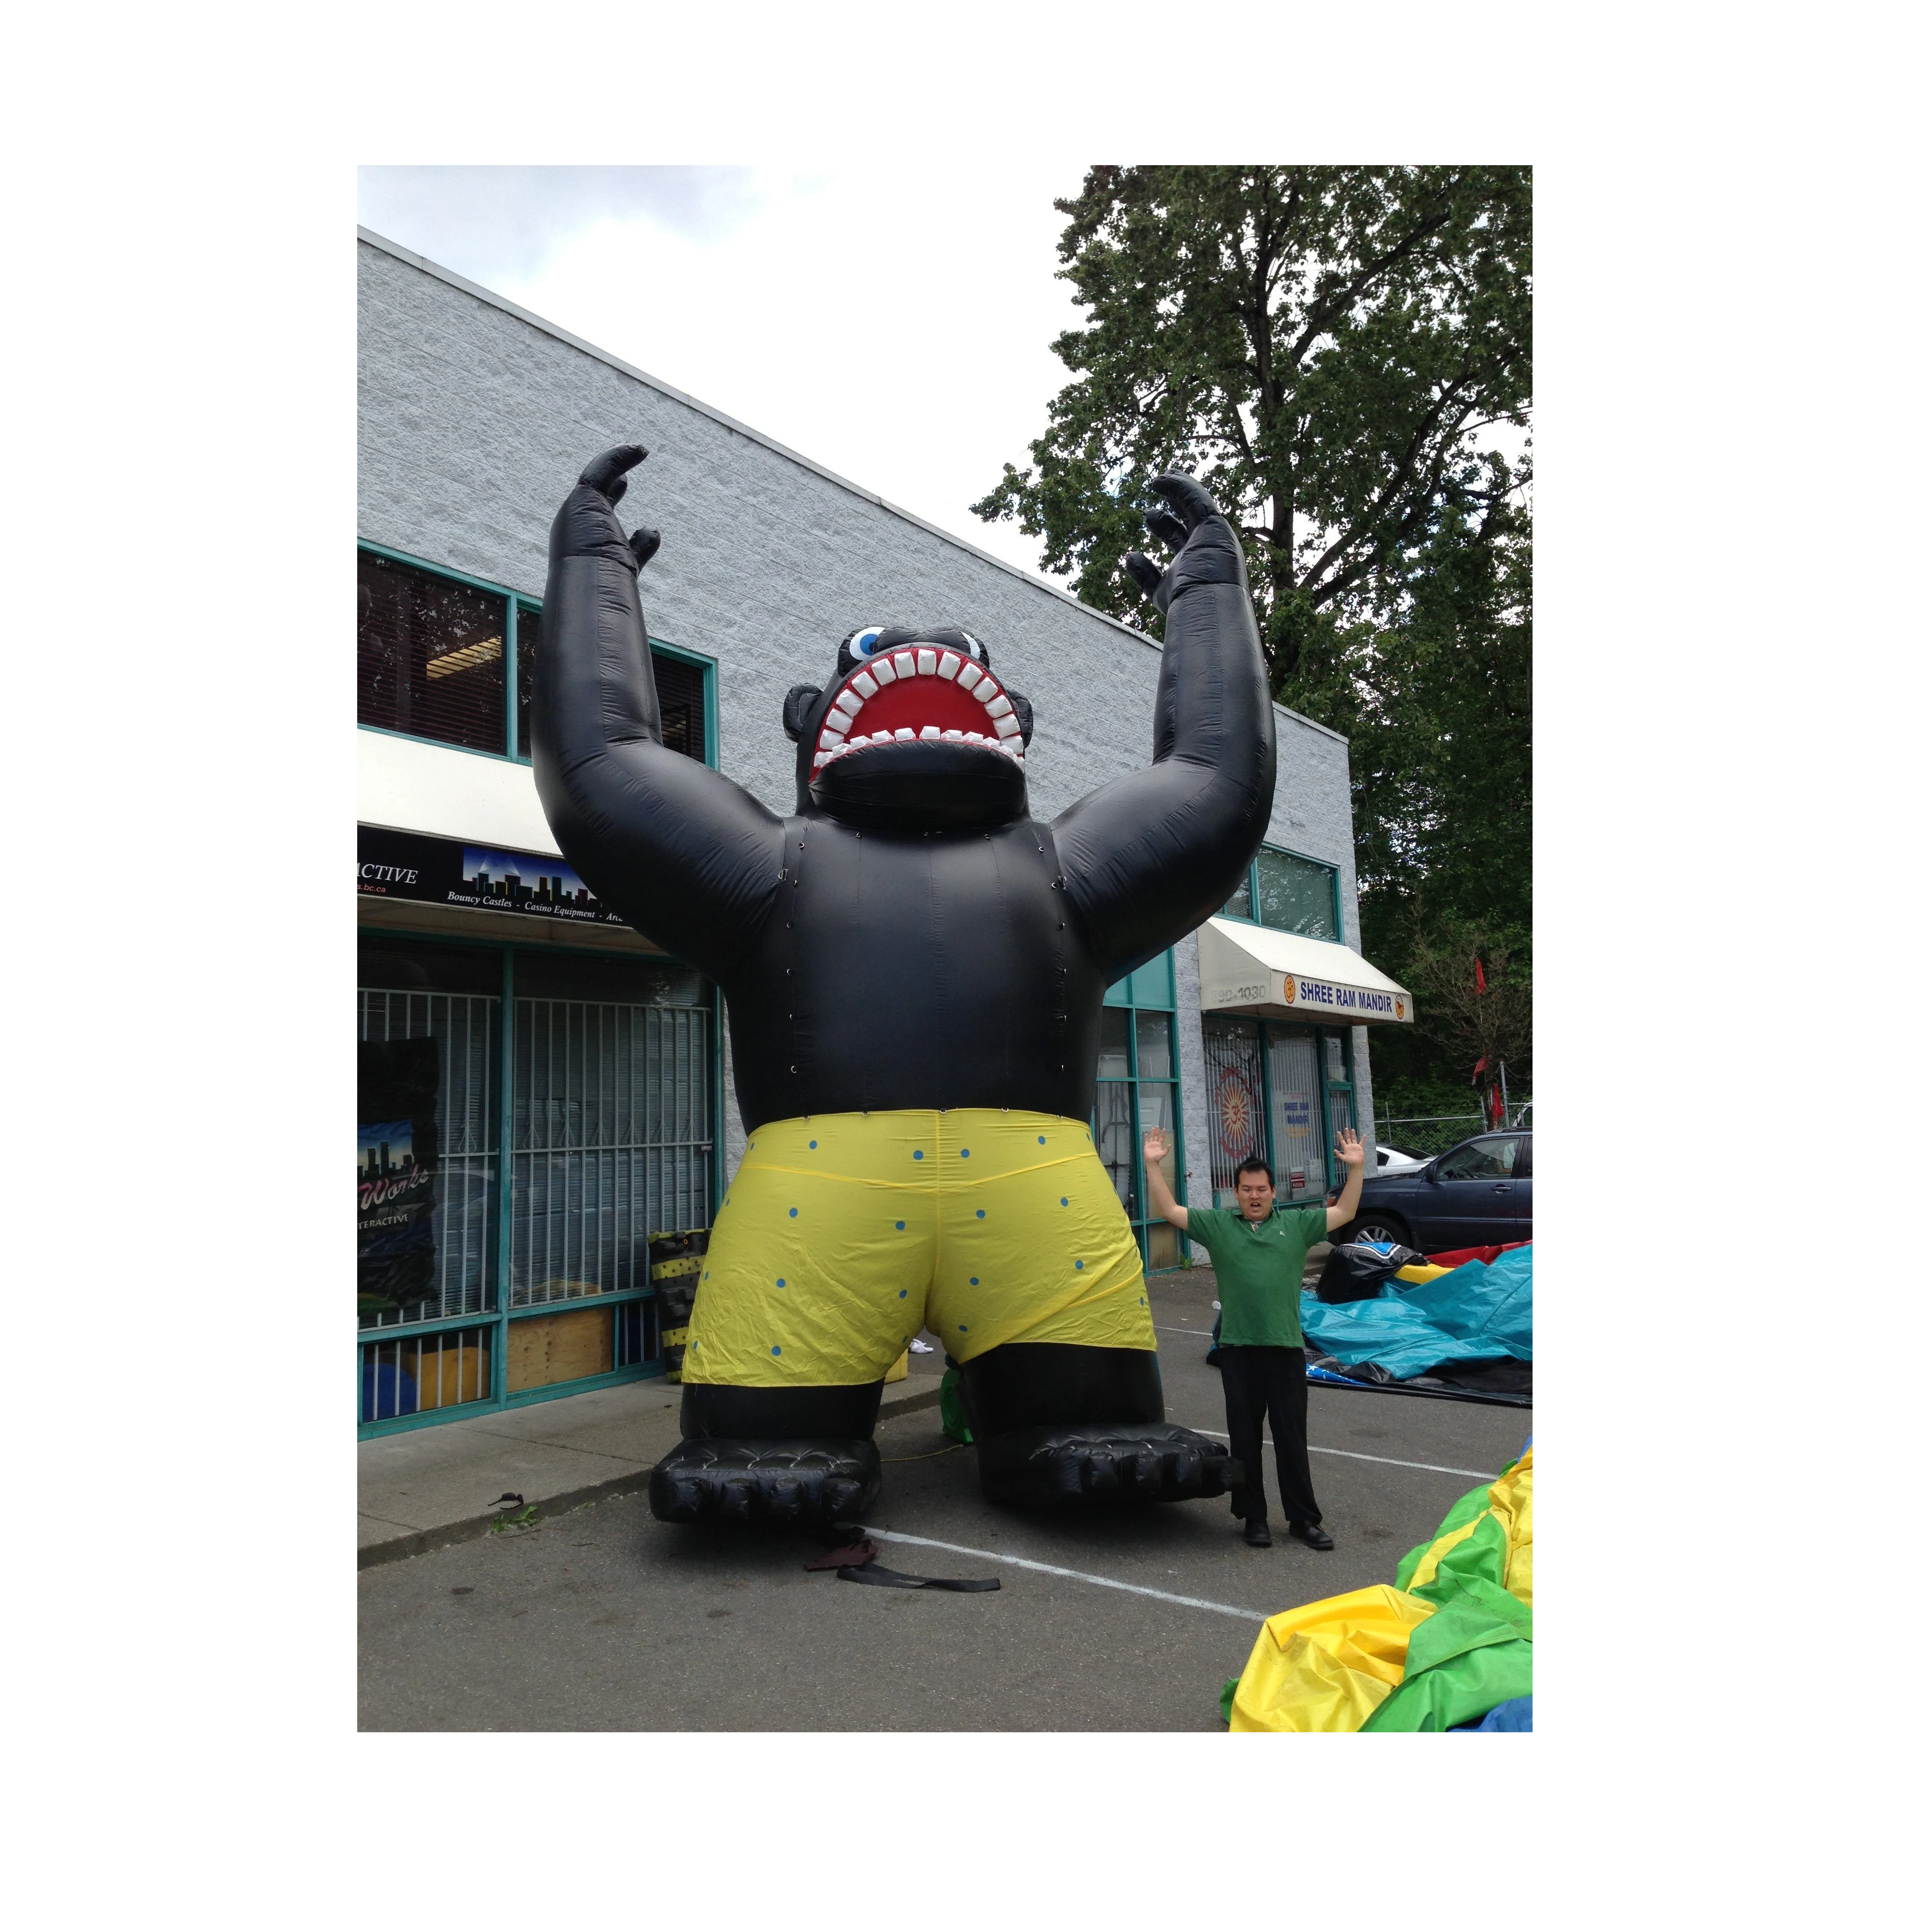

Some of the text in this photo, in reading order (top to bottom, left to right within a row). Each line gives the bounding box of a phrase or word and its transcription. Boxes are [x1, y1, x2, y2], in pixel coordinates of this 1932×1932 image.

[447, 891, 480, 905] Bouncy
[483, 896, 512, 907] Castles
[525, 902, 552, 913] Casino
[553, 906, 596, 918] Equipment
[1301, 982, 1392, 1013] SHREE RAM MANDIR
[357, 1163, 428, 1210] Works
